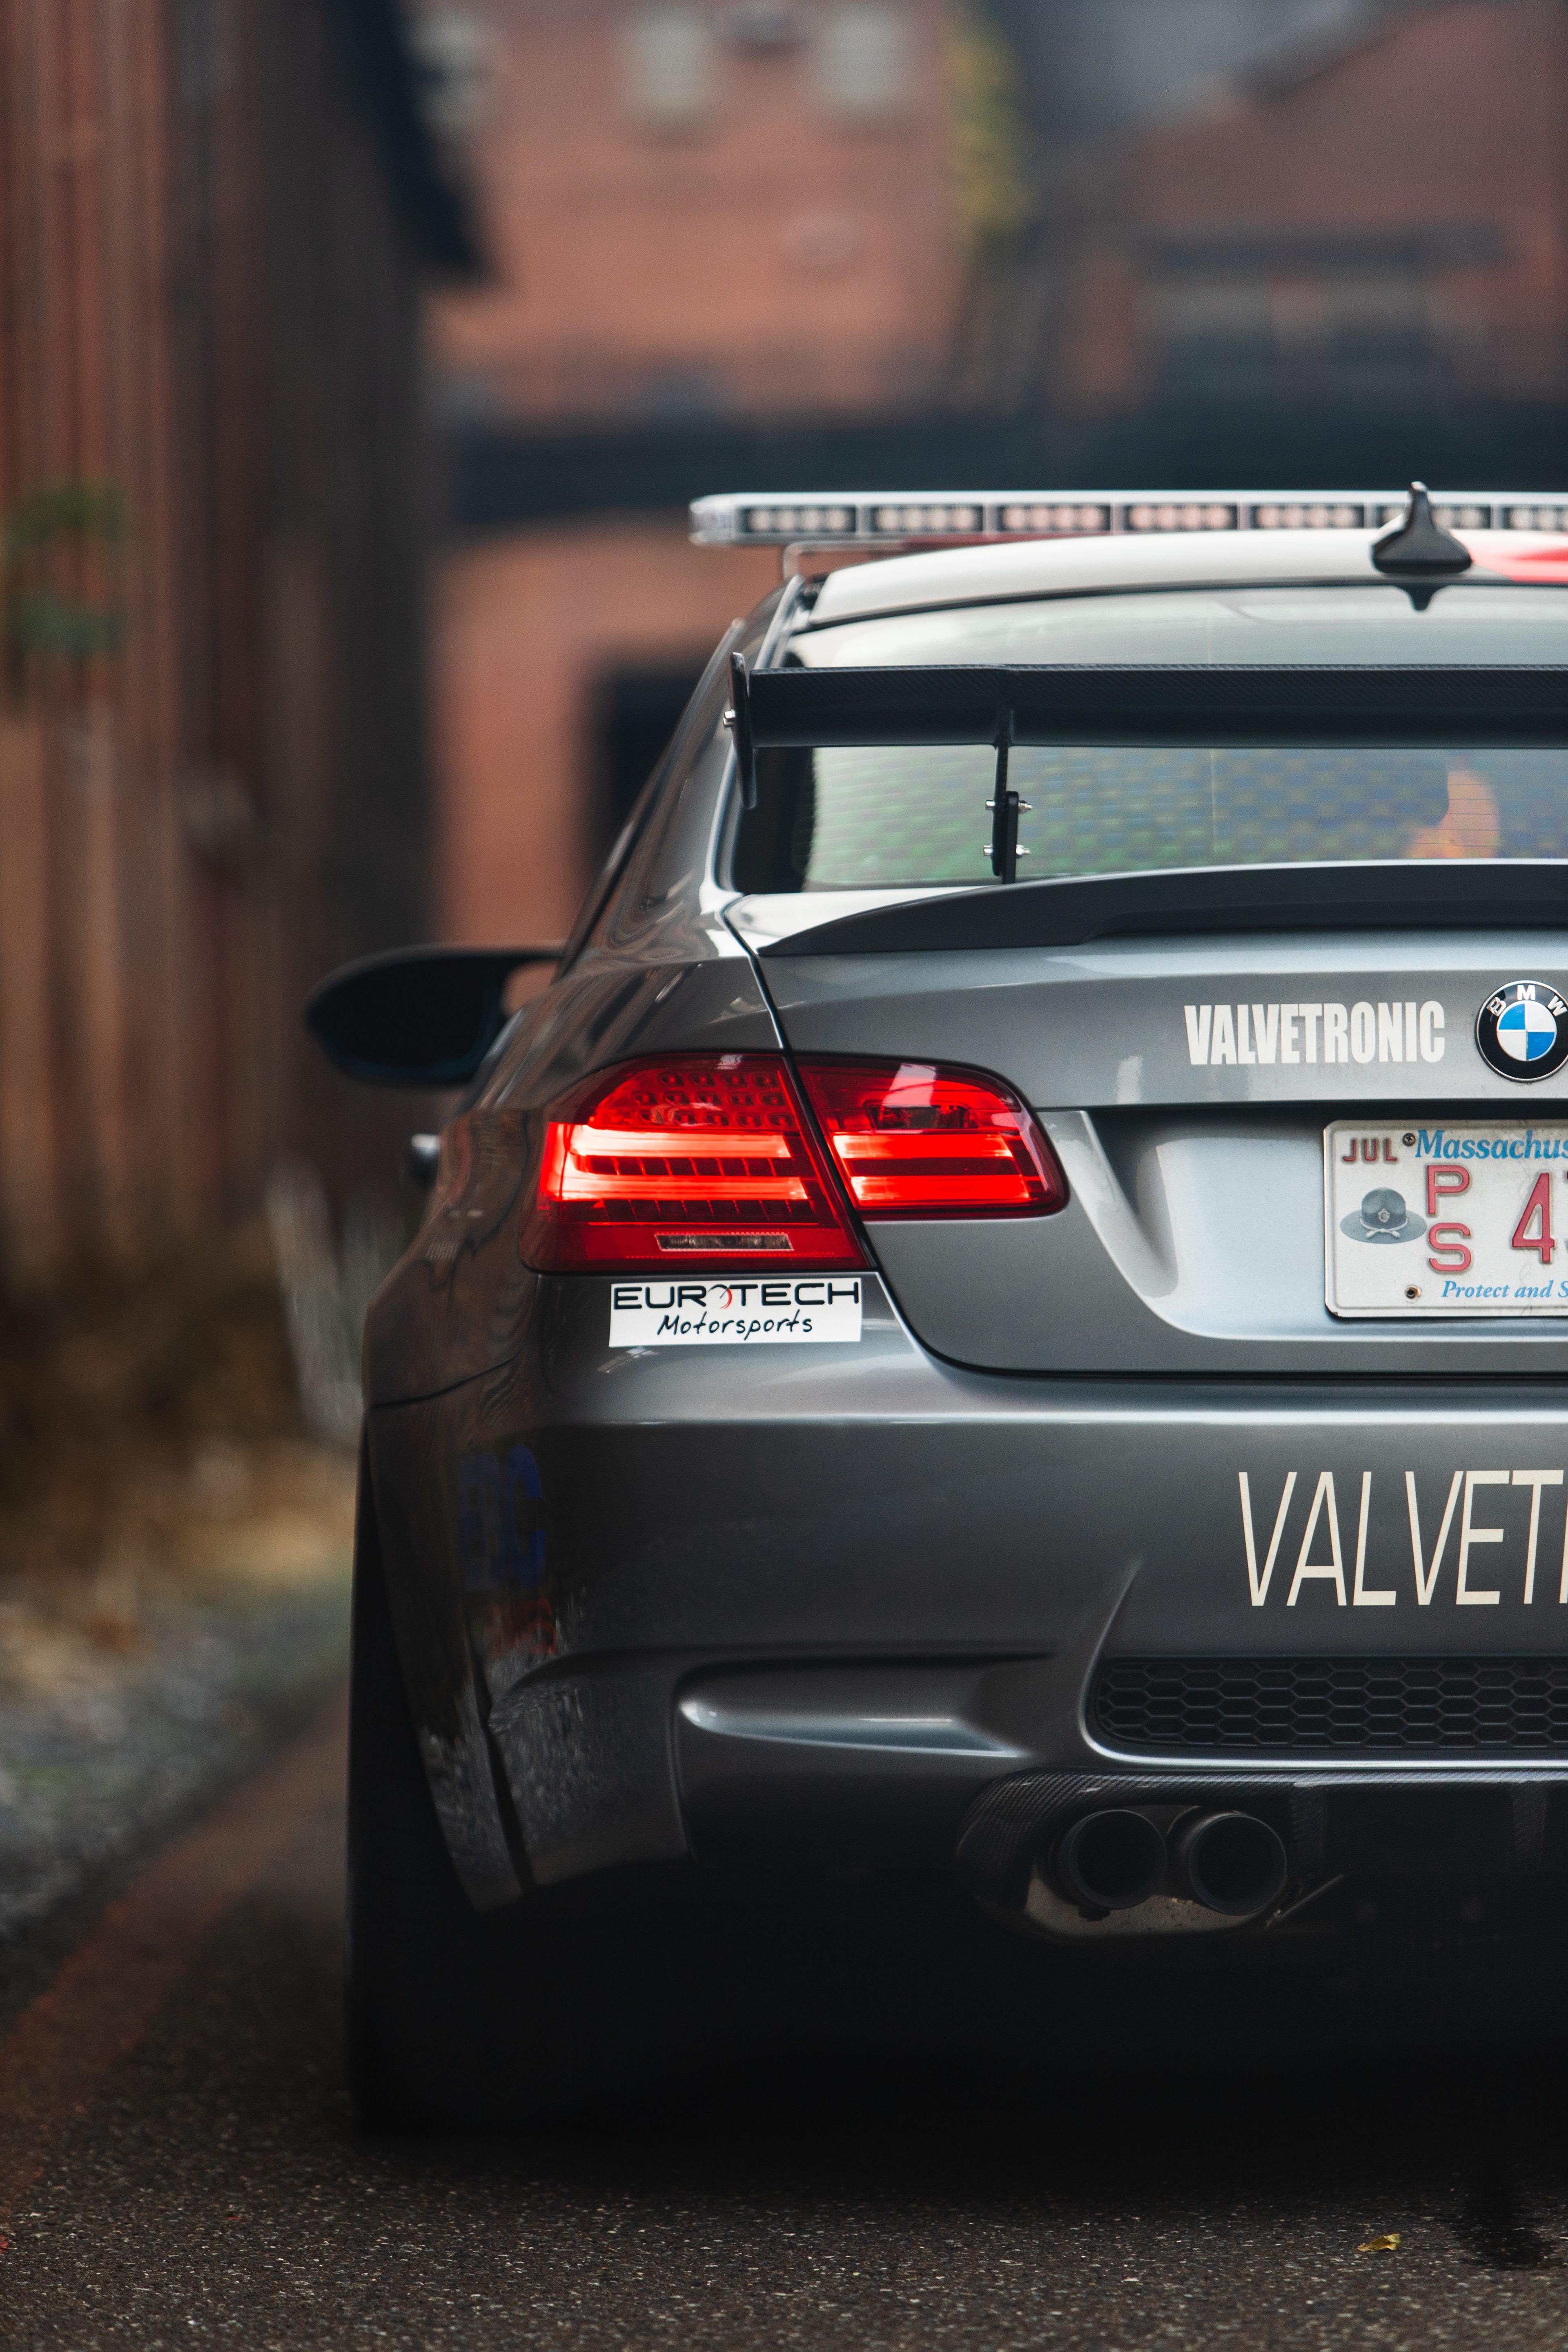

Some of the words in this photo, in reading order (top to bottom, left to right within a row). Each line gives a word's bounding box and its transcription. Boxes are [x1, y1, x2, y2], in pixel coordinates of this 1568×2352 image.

[1486, 984, 1568, 1017] BMW
[1184, 1000, 1446, 1065] VALVETRONIC
[1343, 1138, 1398, 1162] JUL
[613, 1281, 859, 1310] EUROTECH
[1441, 1280, 1510, 1298] Protect
[1514, 1280, 1554, 1298] and
[657, 1309, 813, 1341] Motorsports
[1238, 1469, 1568, 1606] VALVET
